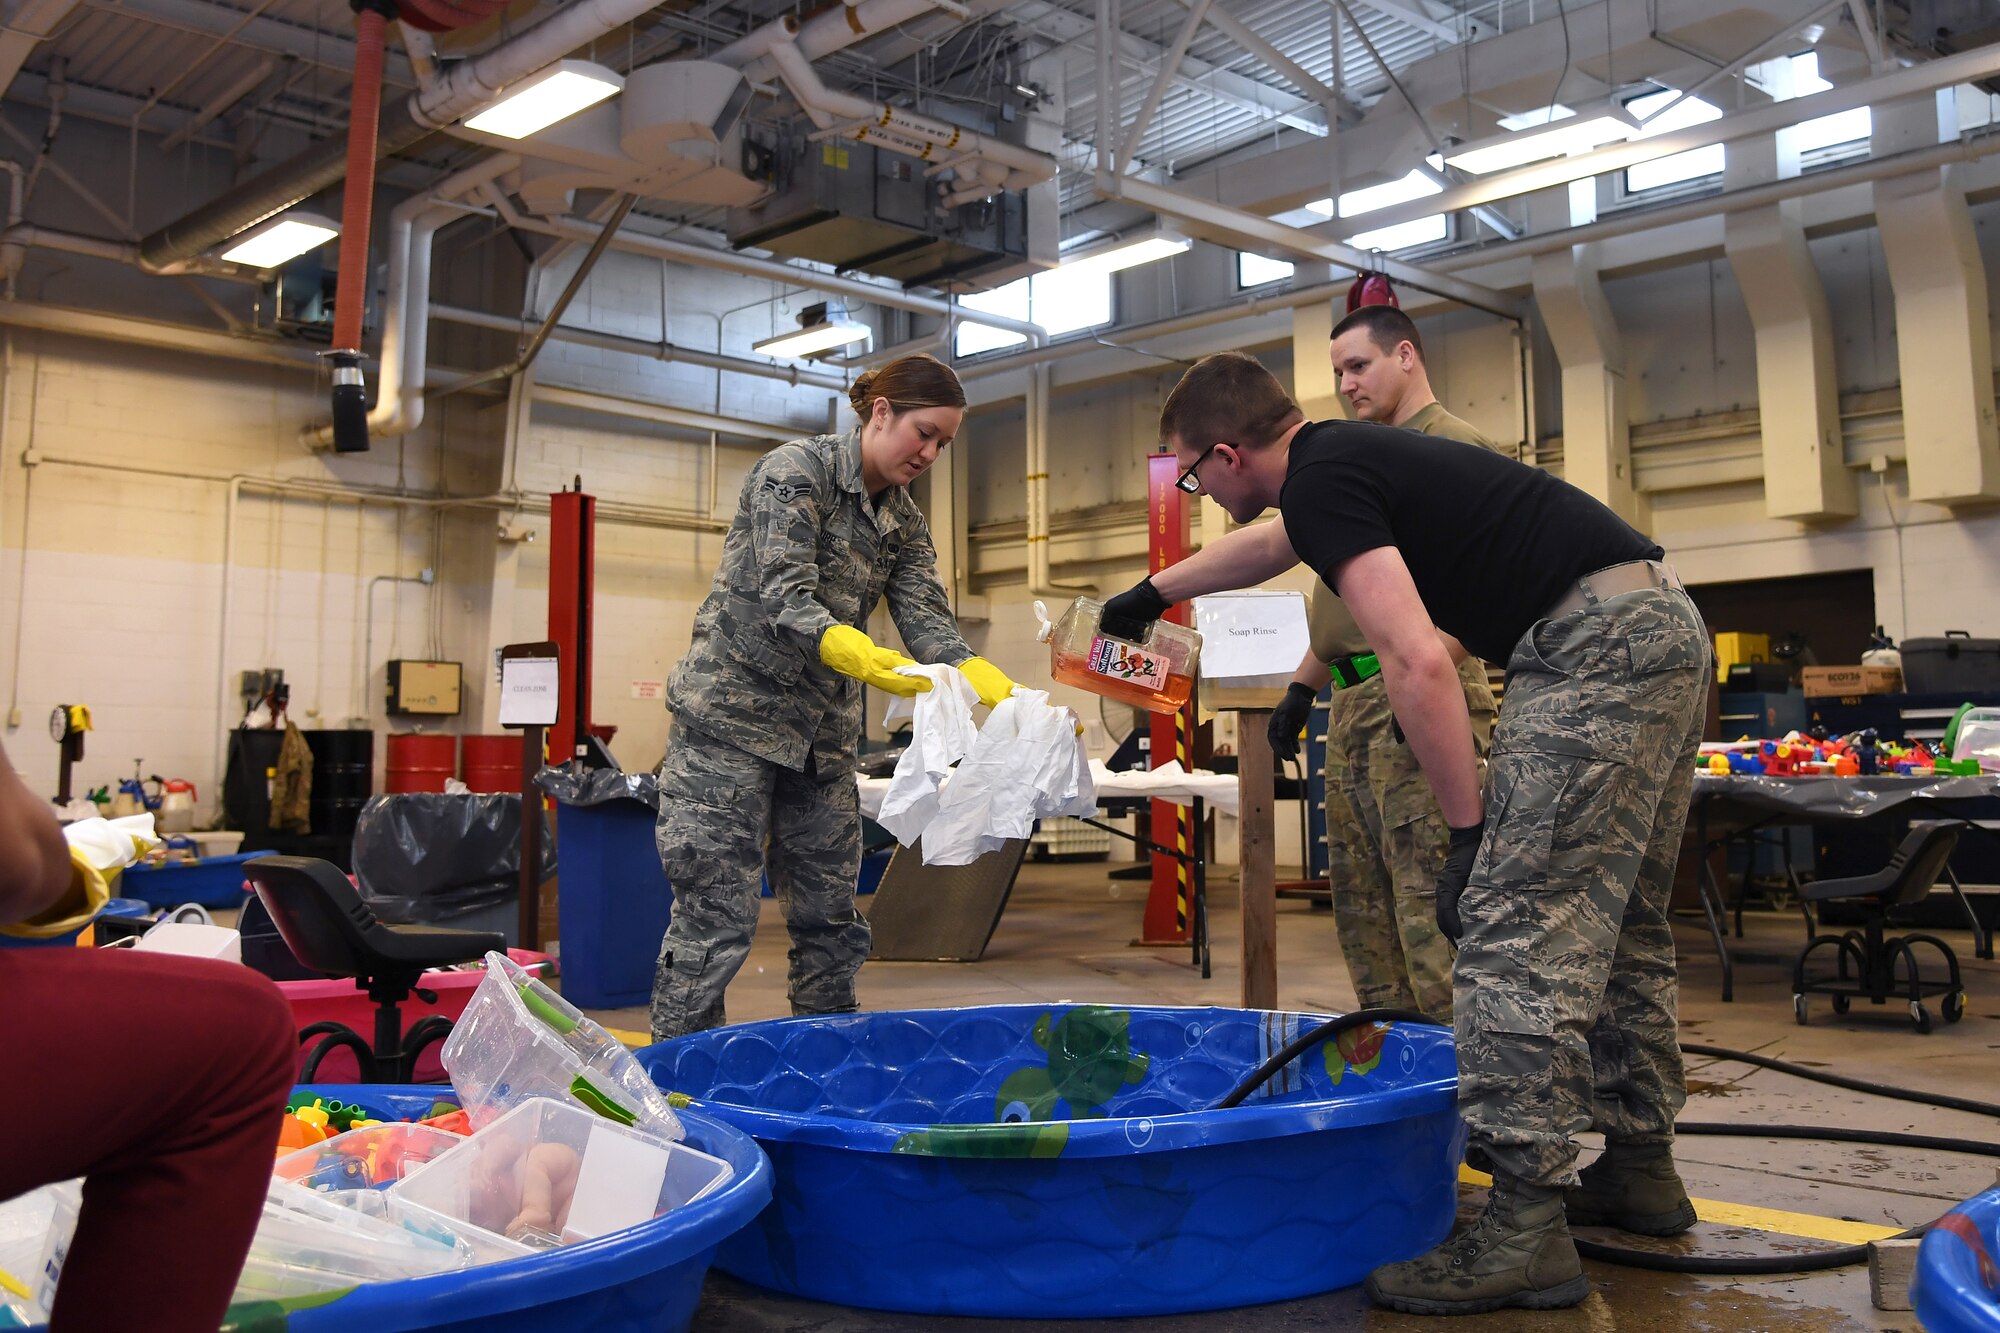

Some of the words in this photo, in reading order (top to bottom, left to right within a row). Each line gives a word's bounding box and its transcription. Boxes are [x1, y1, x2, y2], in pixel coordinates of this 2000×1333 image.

[1228, 627, 1251, 637] Soap
[1253, 627, 1277, 635] Rinse
[1089, 654, 1099, 671] GREAT
[1094, 639, 1104, 654] VALUE
[1099, 642, 1113, 673] Softsoap
